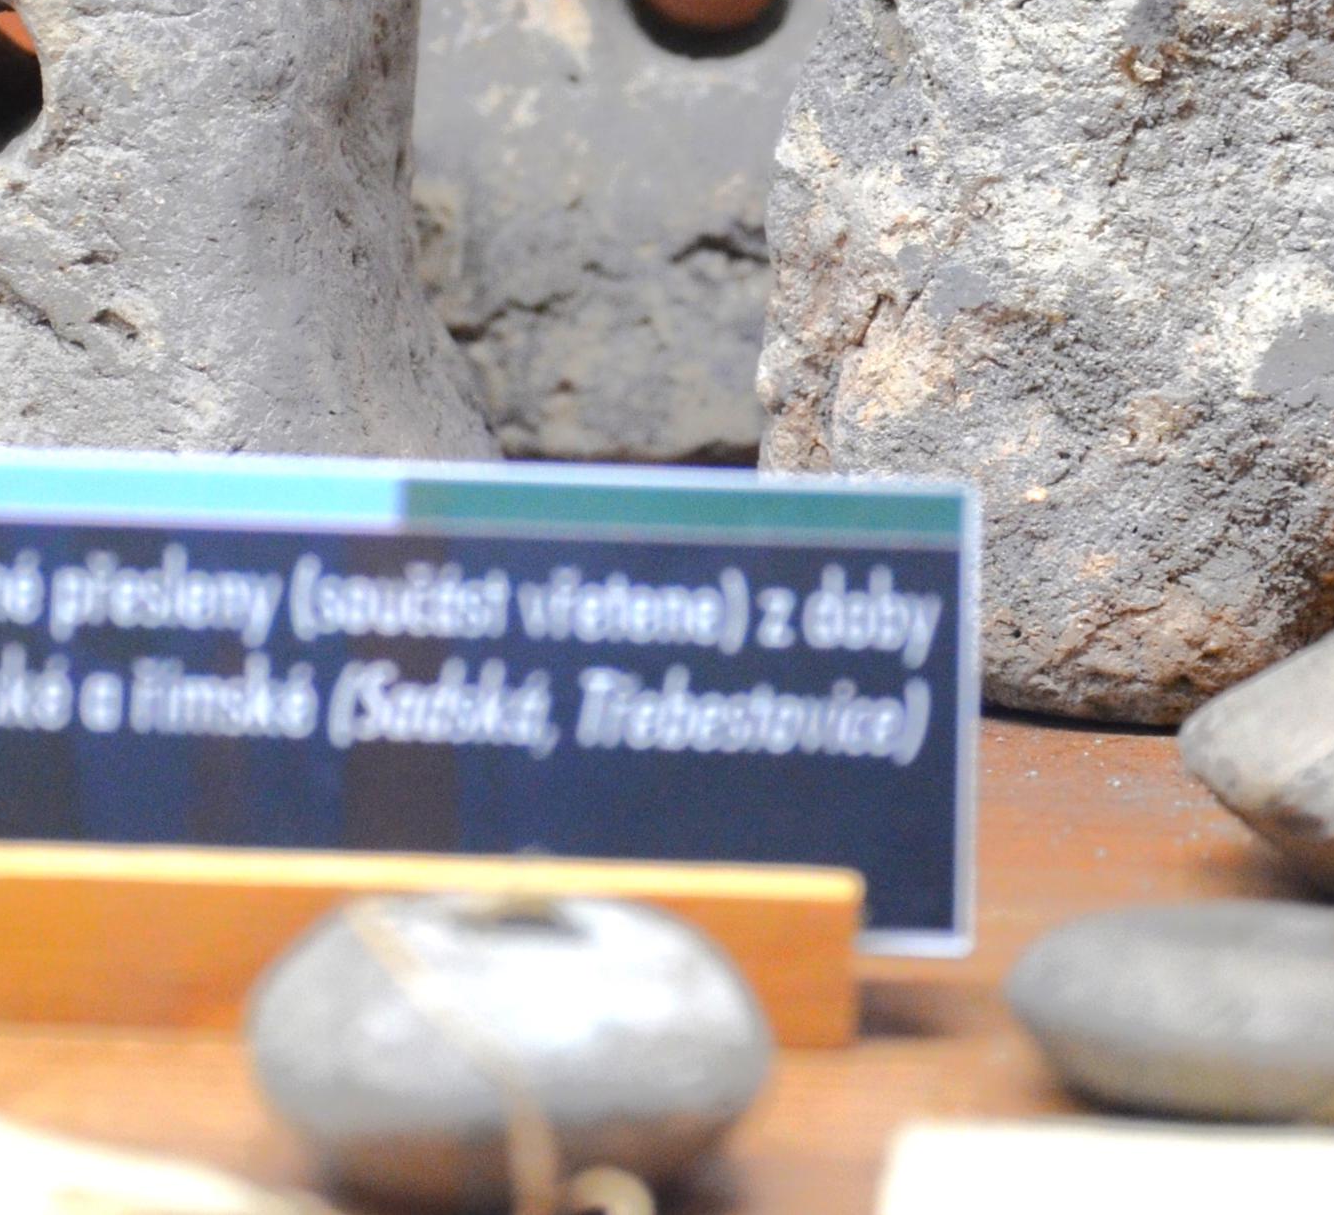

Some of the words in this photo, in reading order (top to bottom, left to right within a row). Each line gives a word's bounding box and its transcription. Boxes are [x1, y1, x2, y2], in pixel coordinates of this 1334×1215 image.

[52, 542, 279, 647] přesleny
[520, 569, 748, 655] vřetene)
[757, 589, 794, 646] z
[802, 564, 942, 668] doby
[79, 676, 122, 732] a
[129, 652, 319, 741] římské
[329, 657, 563, 759] (Sadská,
[576, 664, 930, 765] Třebestovice)
